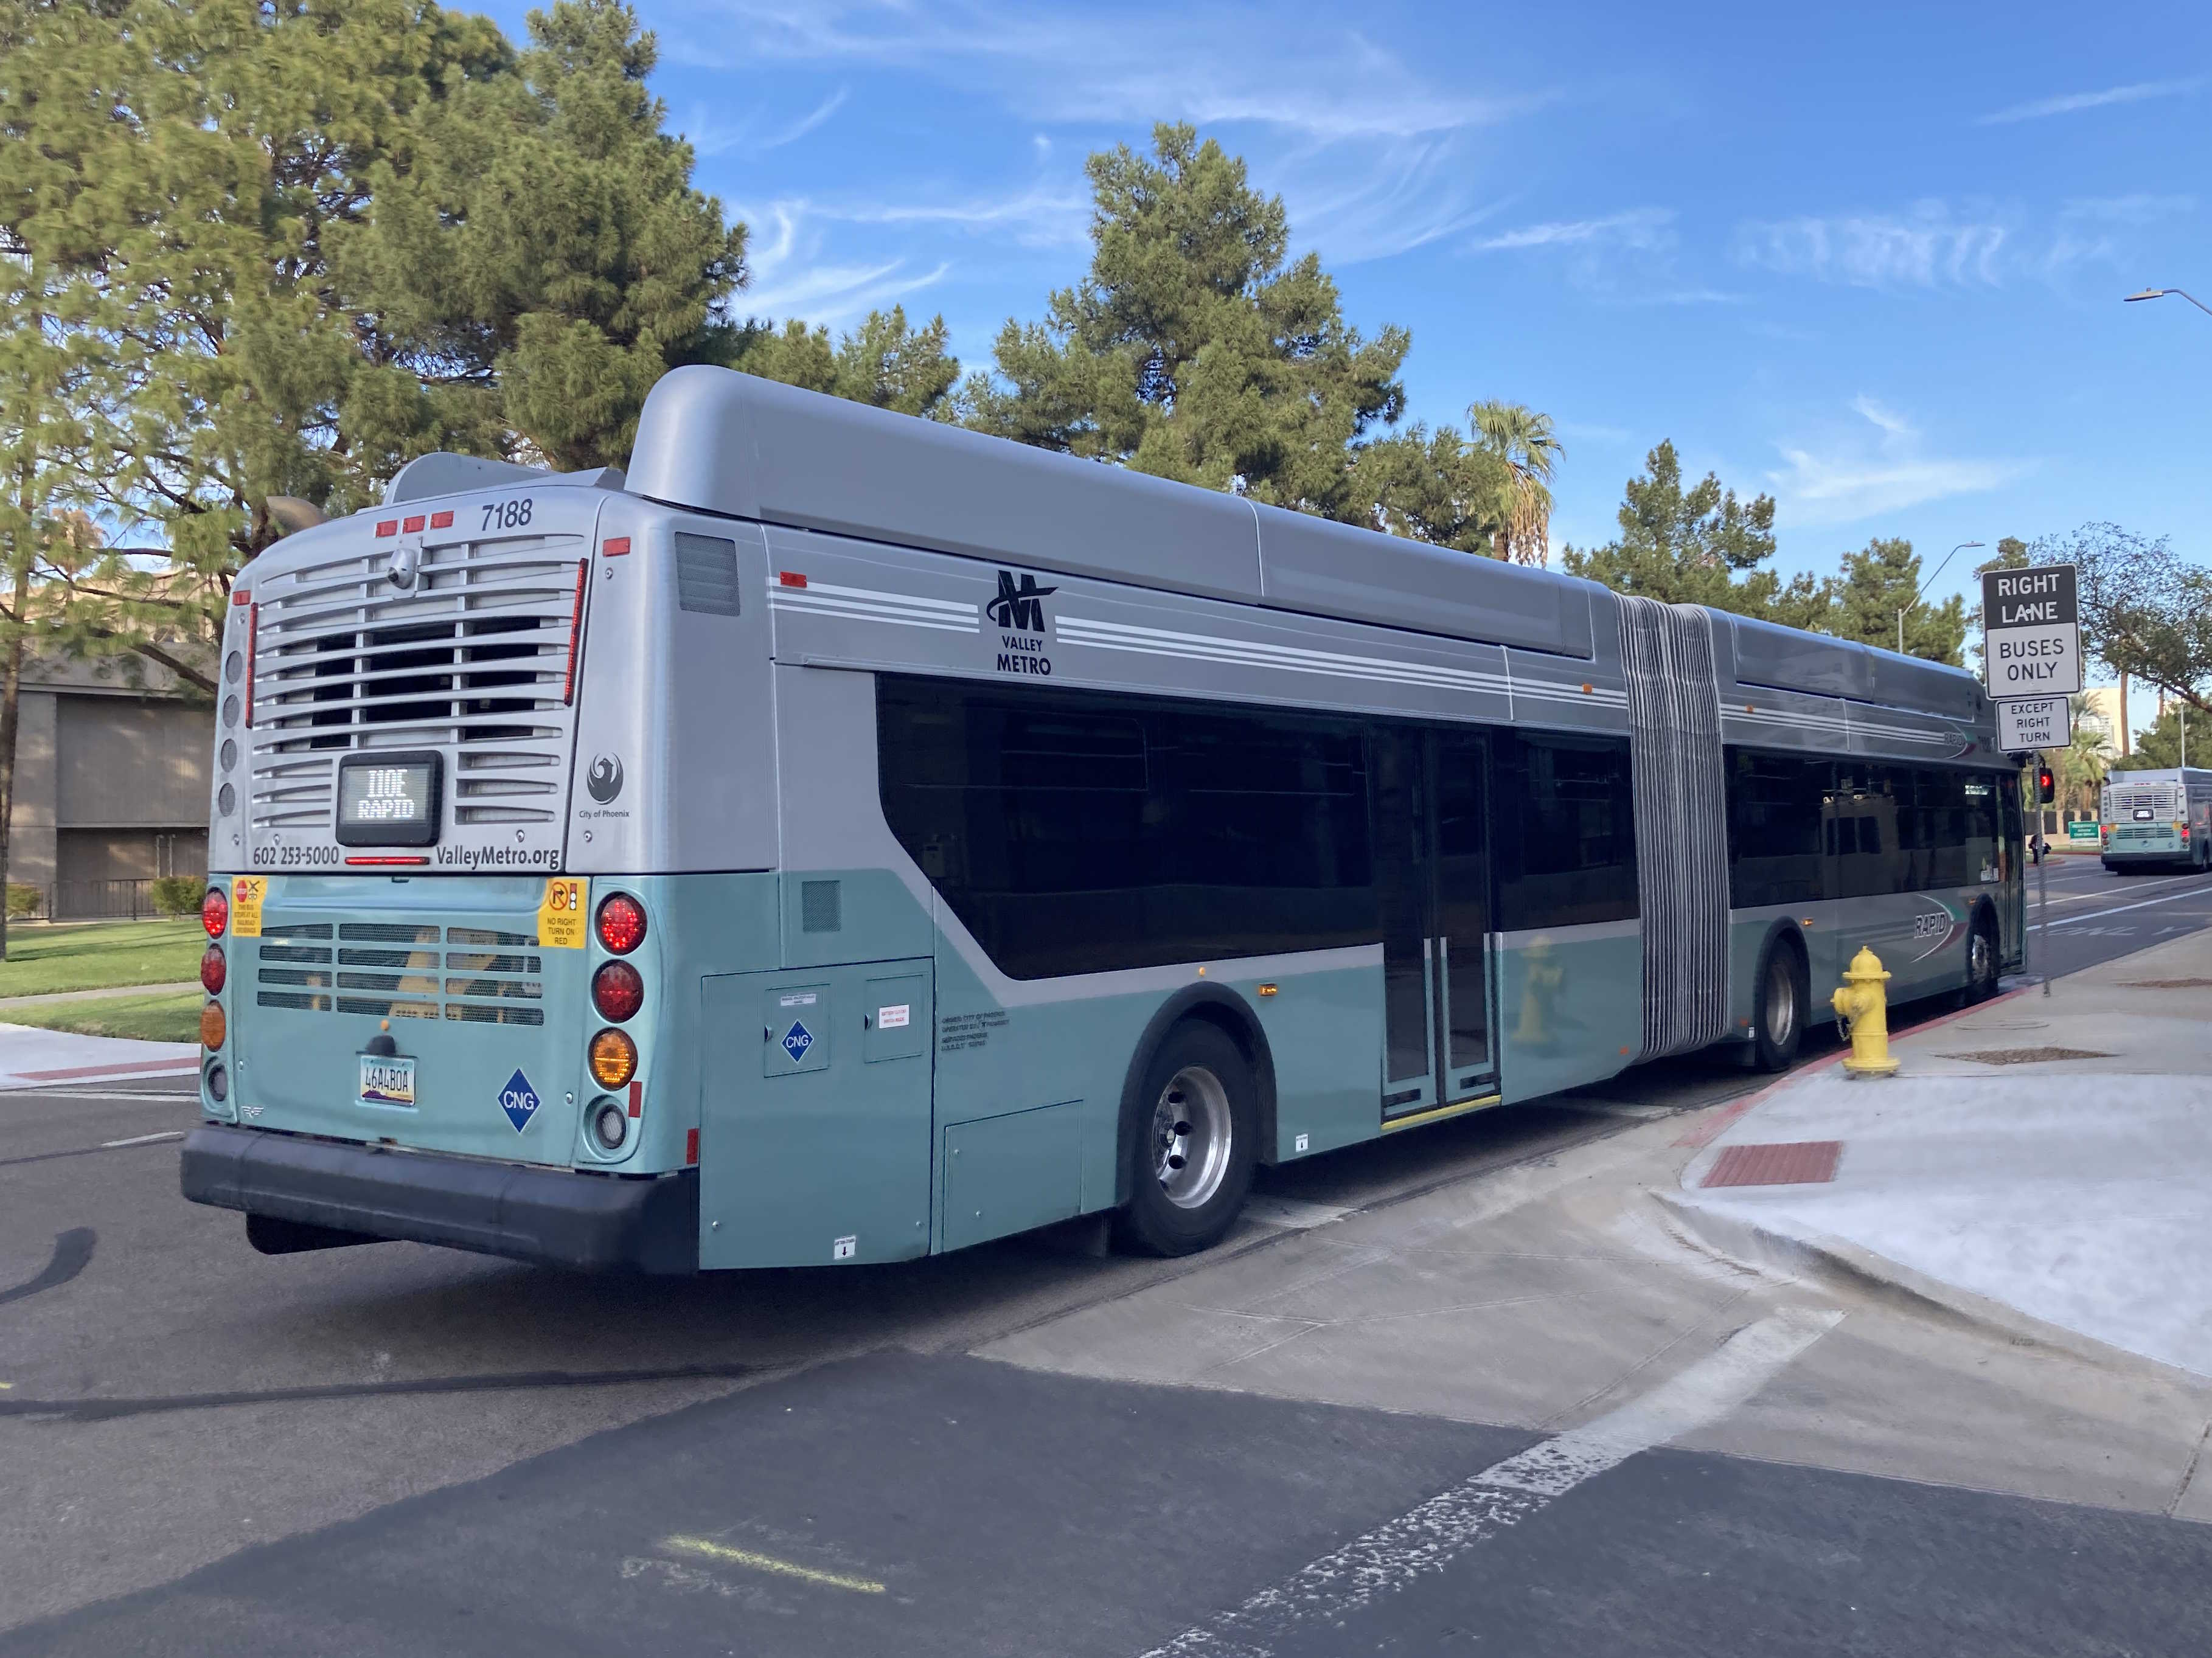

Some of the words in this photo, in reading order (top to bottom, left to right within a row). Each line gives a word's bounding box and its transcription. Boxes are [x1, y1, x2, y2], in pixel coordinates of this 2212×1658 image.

[482, 499, 532, 531] 7188
[1998, 574, 2059, 596] RIGHT
[2002, 601, 2058, 623] LANE
[1002, 636, 1043, 652] VALLEY
[2000, 639, 2064, 659] BUSES
[997, 653, 1051, 676] METRO
[2008, 661, 2058, 681] ONLY
[2011, 702, 2054, 714] EXCEPT
[2017, 717, 2051, 729] RIGHT
[2019, 732, 2050, 743] TURN
[358, 799, 415, 818] RAPID
[579, 810, 591, 819] City
[254, 847, 276, 864] 602
[281, 846, 339, 864] 253-5000
[437, 845, 560, 870] ValleyMetro.org
[1914, 912, 1947, 938] RAPID
[786, 1035, 809, 1048] CNG
[503, 1091, 534, 1111] CNG
